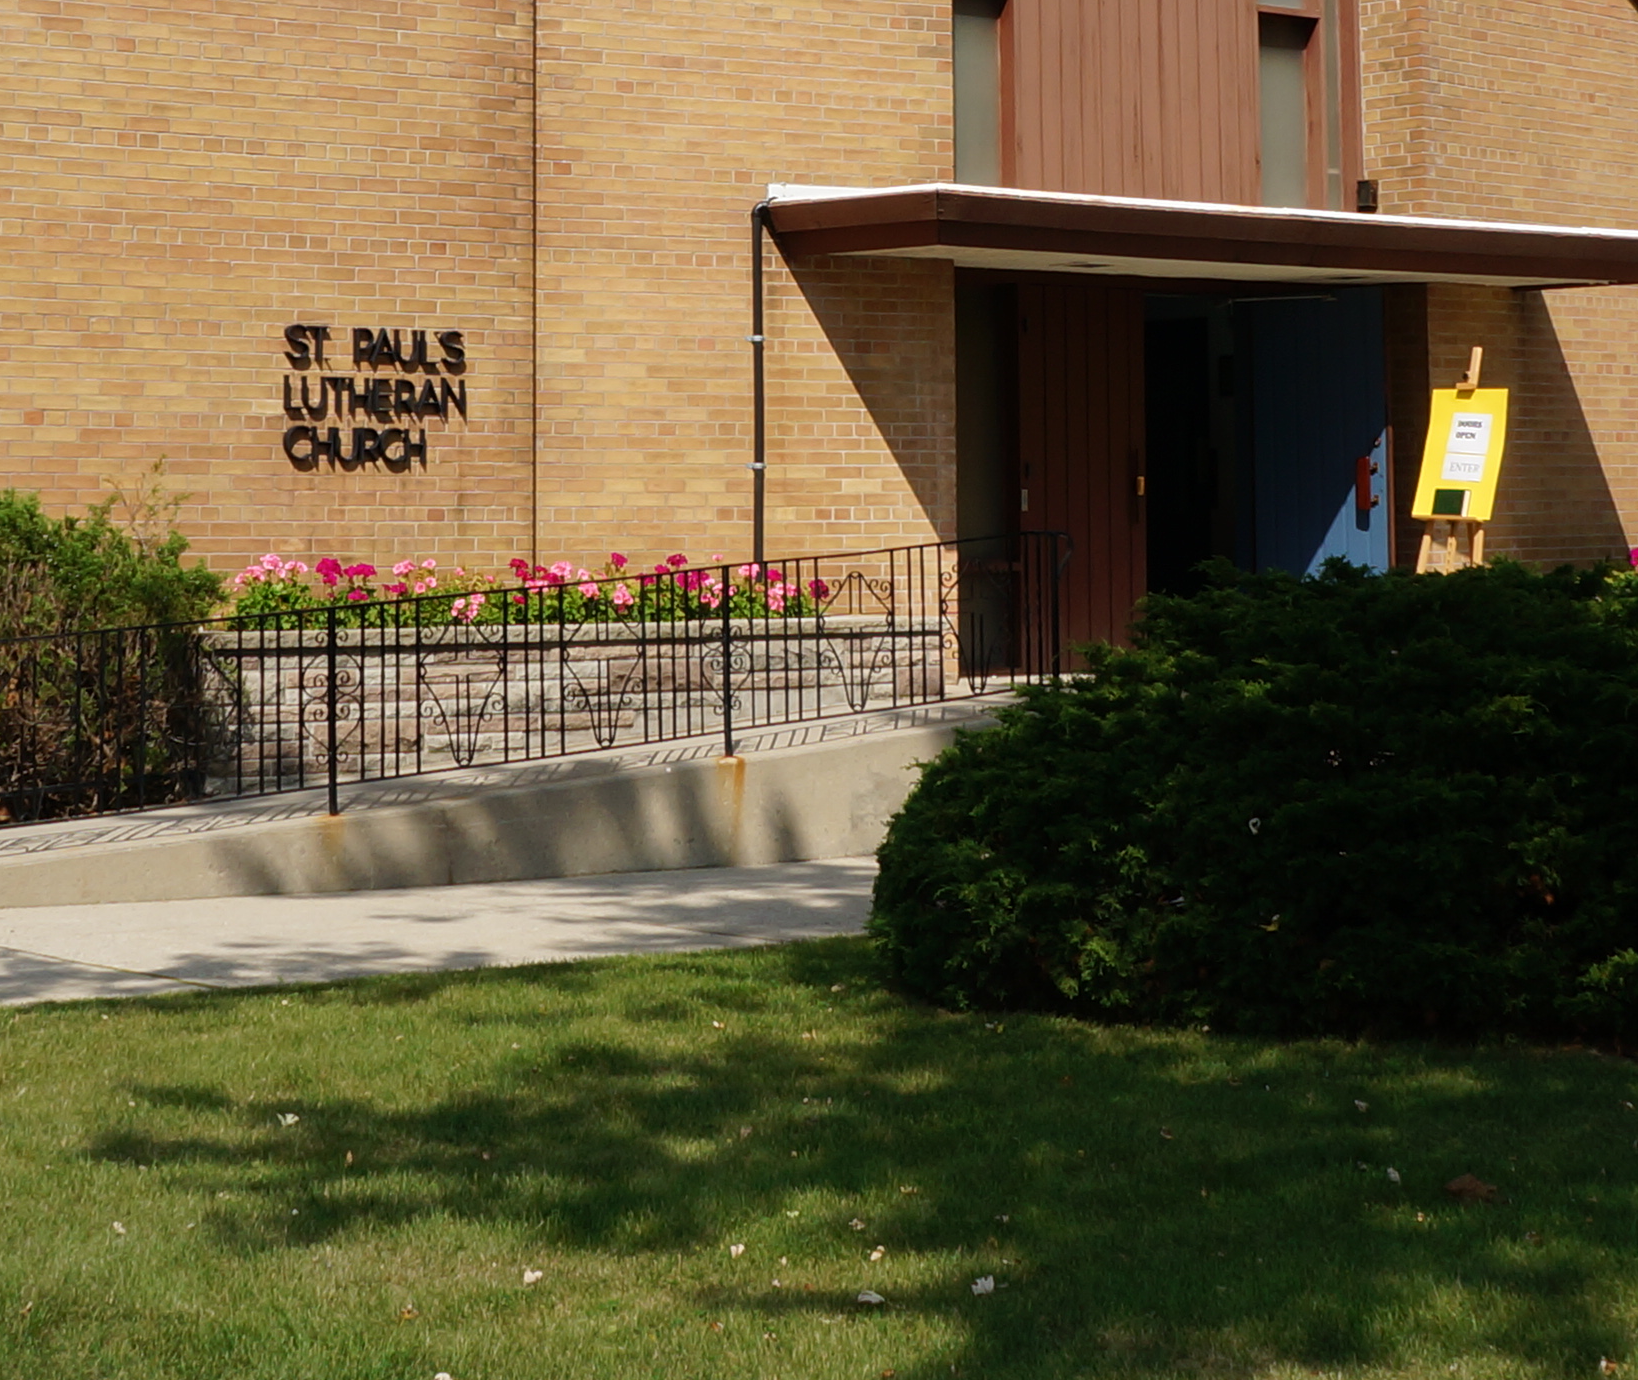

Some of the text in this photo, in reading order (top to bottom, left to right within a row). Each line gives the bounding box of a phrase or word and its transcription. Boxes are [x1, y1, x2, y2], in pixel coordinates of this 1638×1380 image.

[353, 327, 466, 374] PAUL'S
[283, 375, 467, 423] LUTHERAN
[283, 425, 427, 472] CHURCH
[1455, 431, 1476, 439] OPEN
[1449, 462, 1480, 473] ENTER
